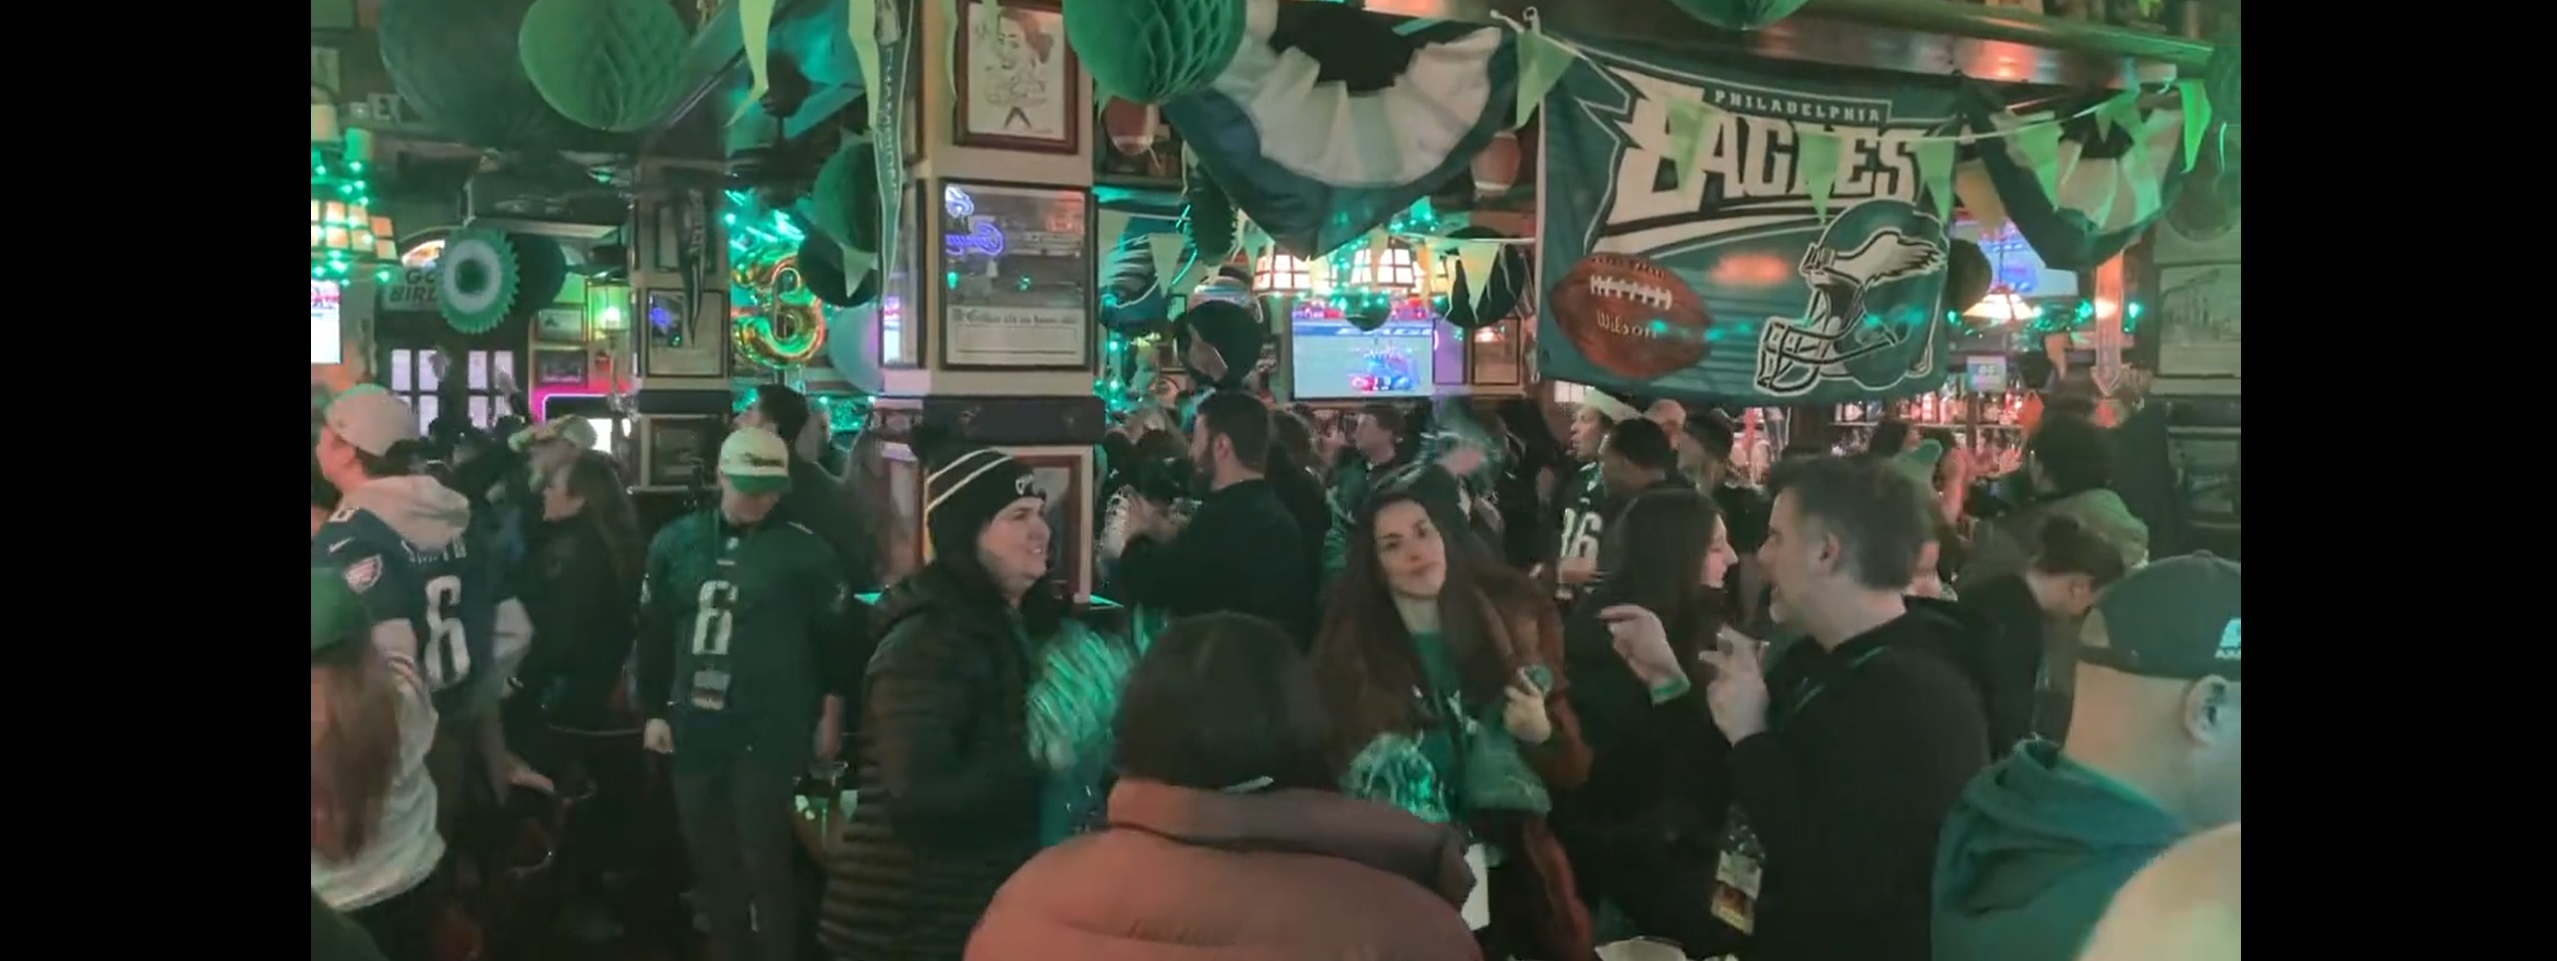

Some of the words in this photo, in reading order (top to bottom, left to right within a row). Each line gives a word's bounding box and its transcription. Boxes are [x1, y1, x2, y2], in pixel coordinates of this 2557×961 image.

[1714, 90, 1880, 123] PHILADELPHIA
[1606, 66, 1928, 225] EAGES
[1597, 309, 1658, 339] Wilson
[425, 574, 471, 691] 6
[692, 580, 739, 655] 6
